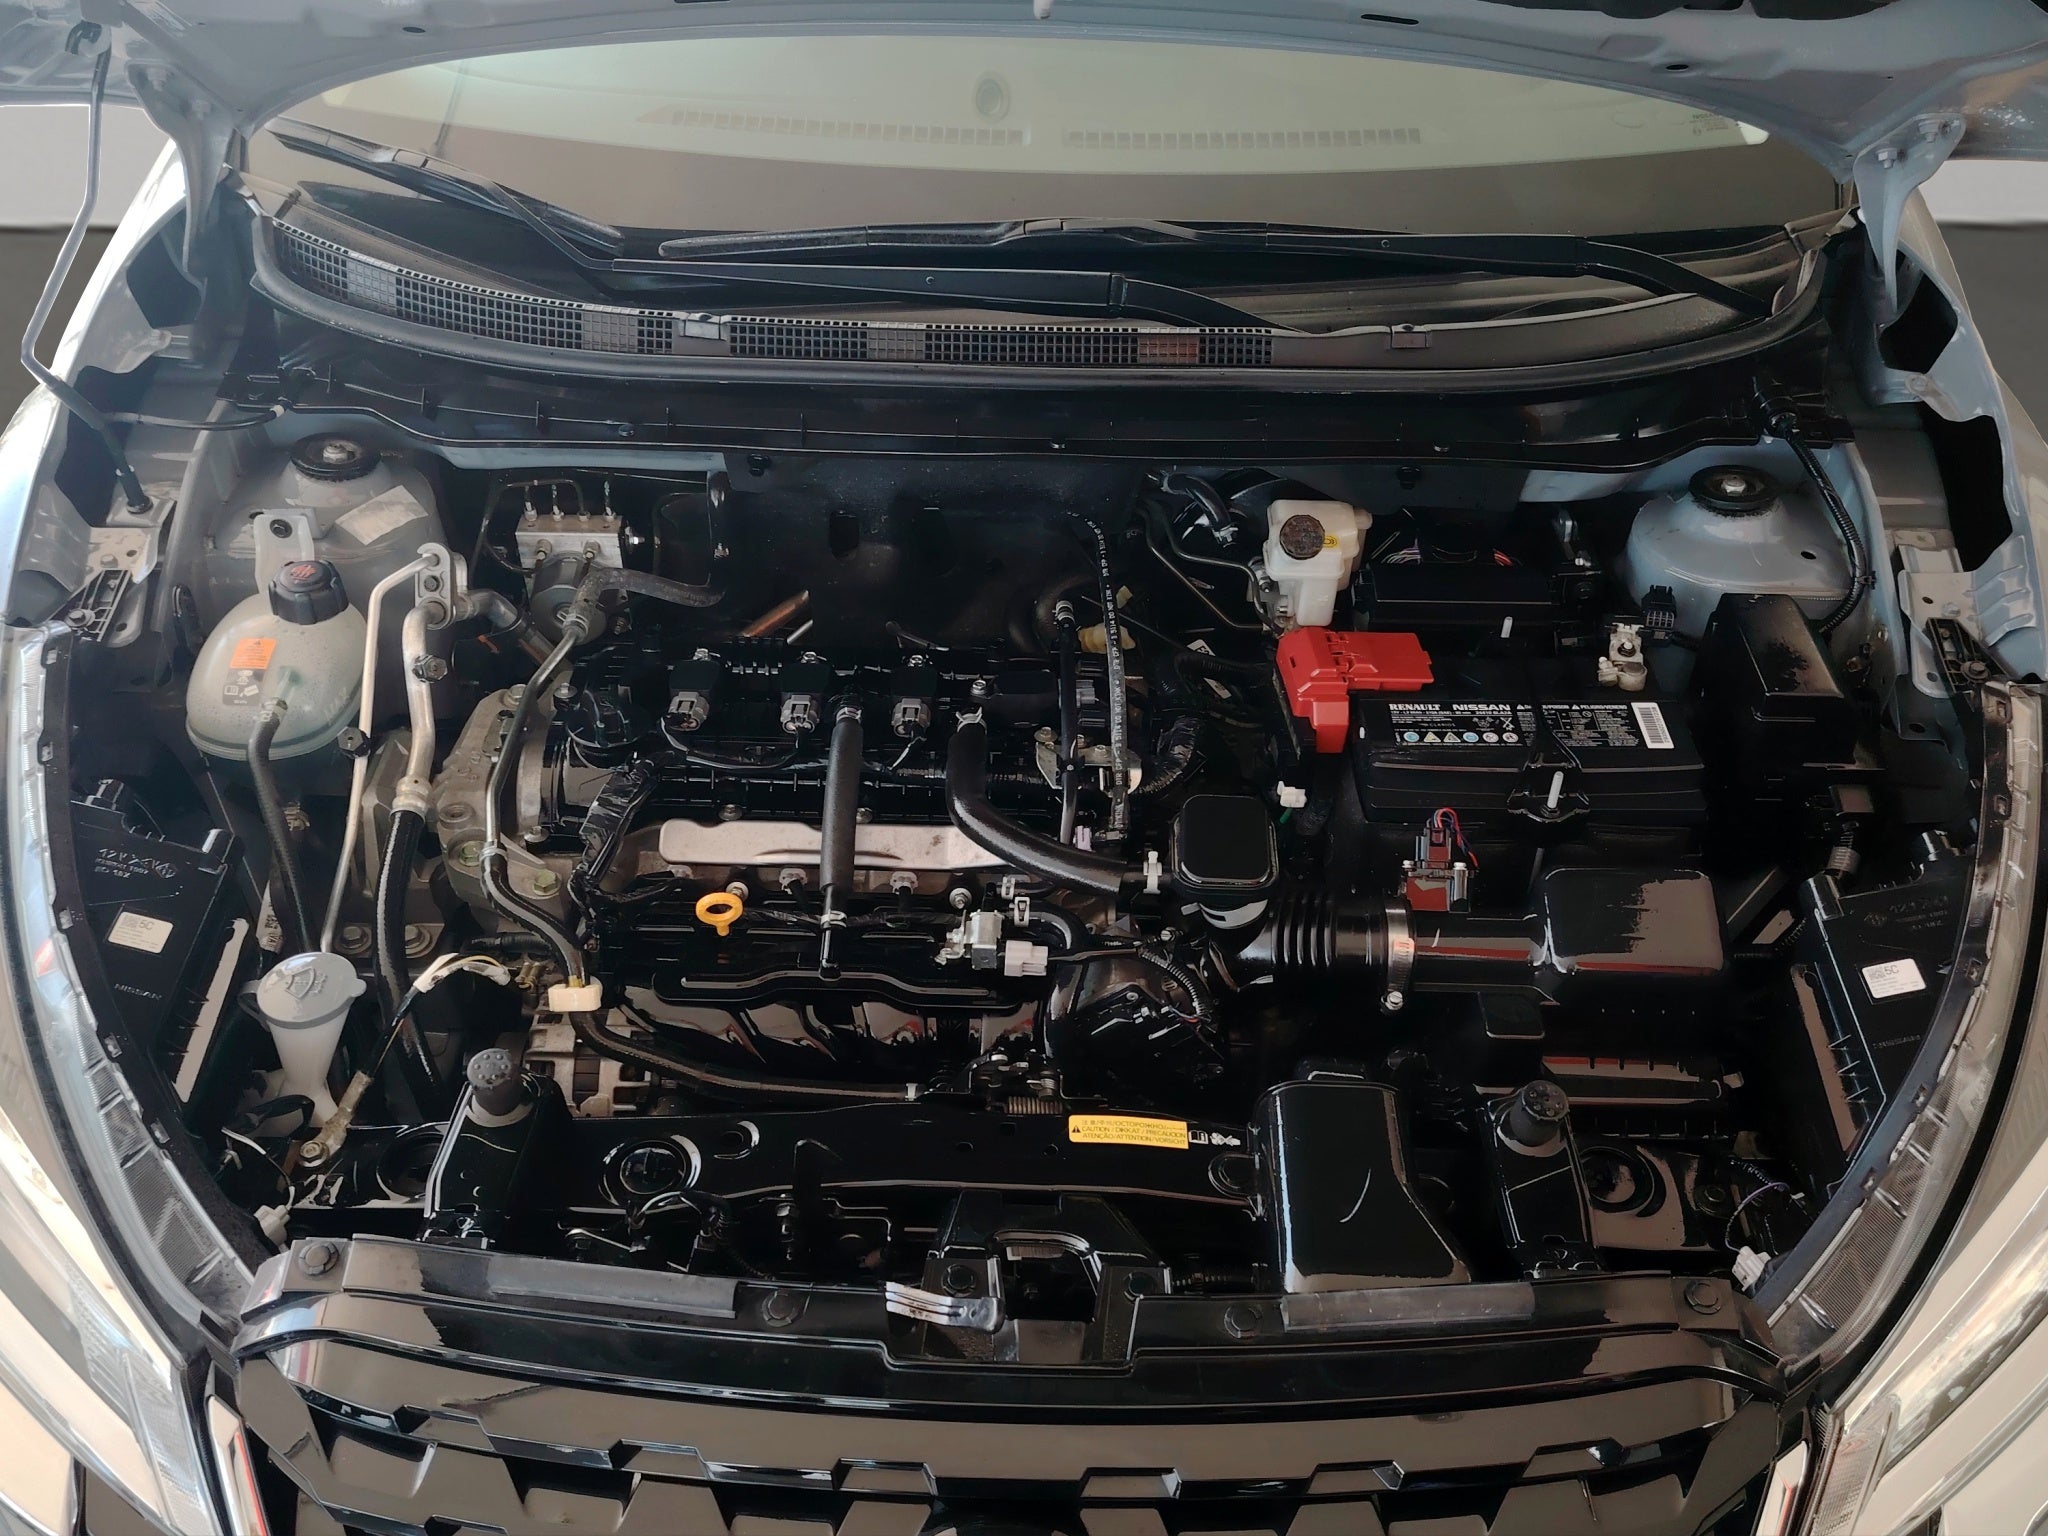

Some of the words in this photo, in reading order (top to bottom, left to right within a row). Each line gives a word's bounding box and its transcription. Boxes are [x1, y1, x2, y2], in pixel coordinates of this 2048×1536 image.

[1389, 703, 1441, 711] RENAULT
[139, 919, 153, 931] 5C
[1884, 964, 1900, 976] 5C
